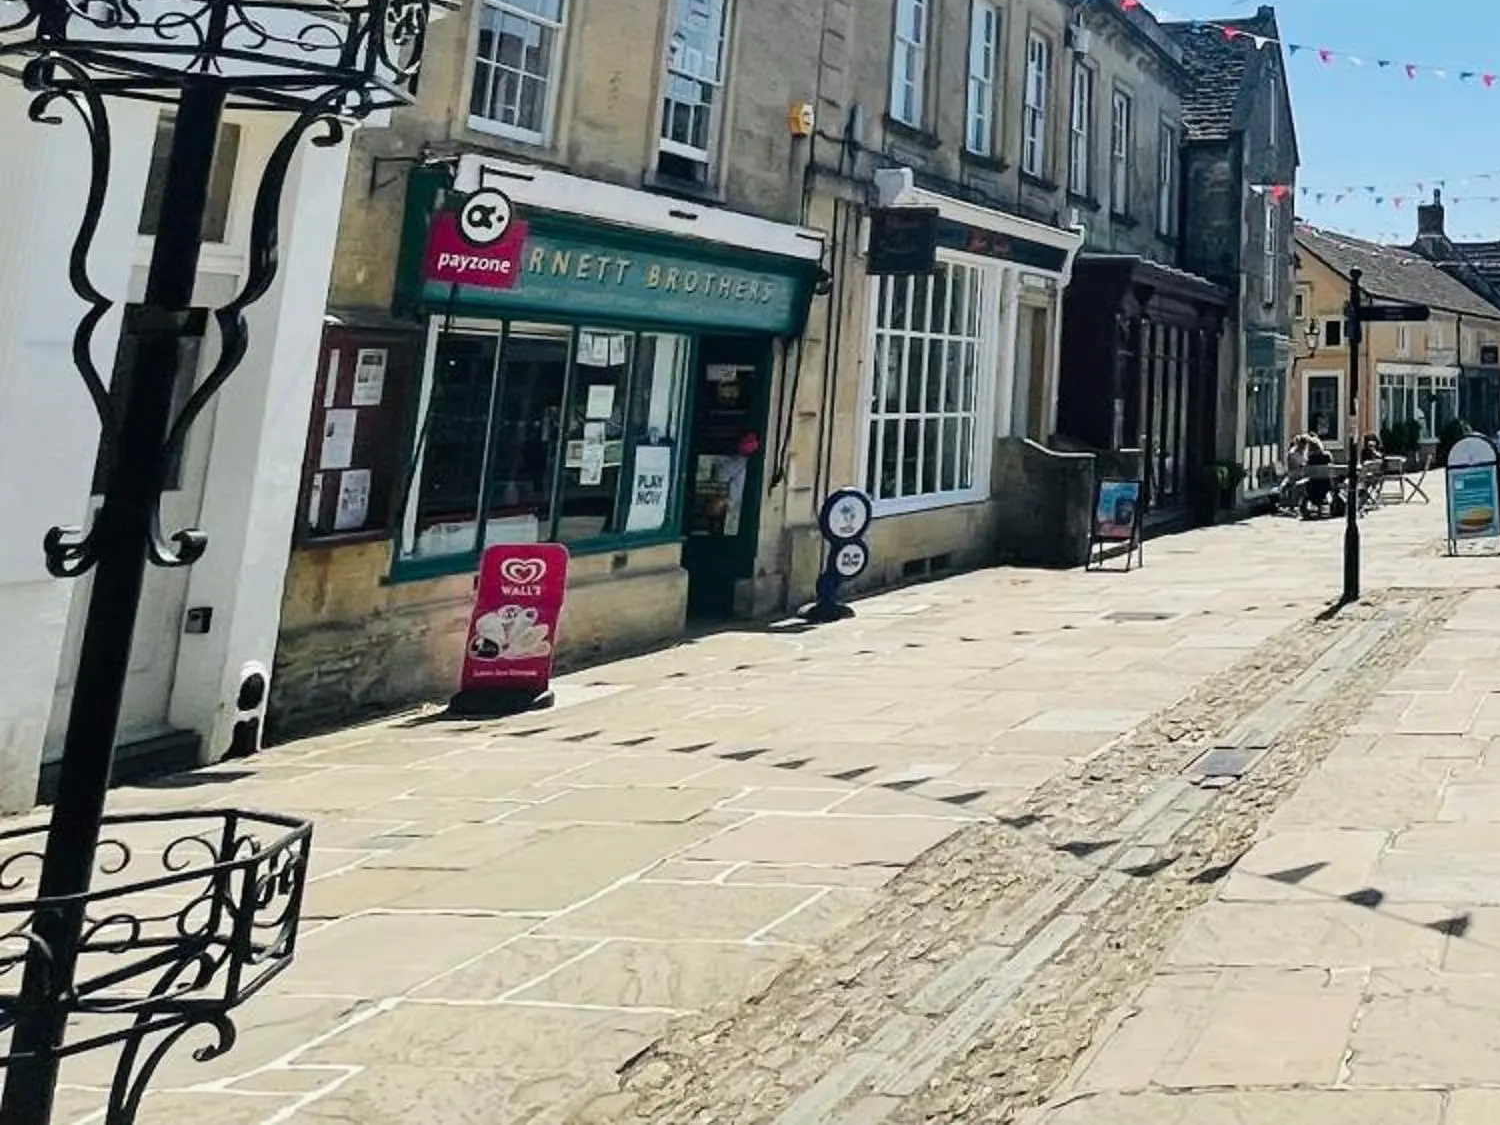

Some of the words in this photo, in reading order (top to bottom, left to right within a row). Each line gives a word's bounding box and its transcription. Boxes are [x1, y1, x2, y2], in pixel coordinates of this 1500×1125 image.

[437, 252, 511, 274] payzone
[520, 247, 631, 285] RNETT
[647, 264, 775, 304] BROTHERS
